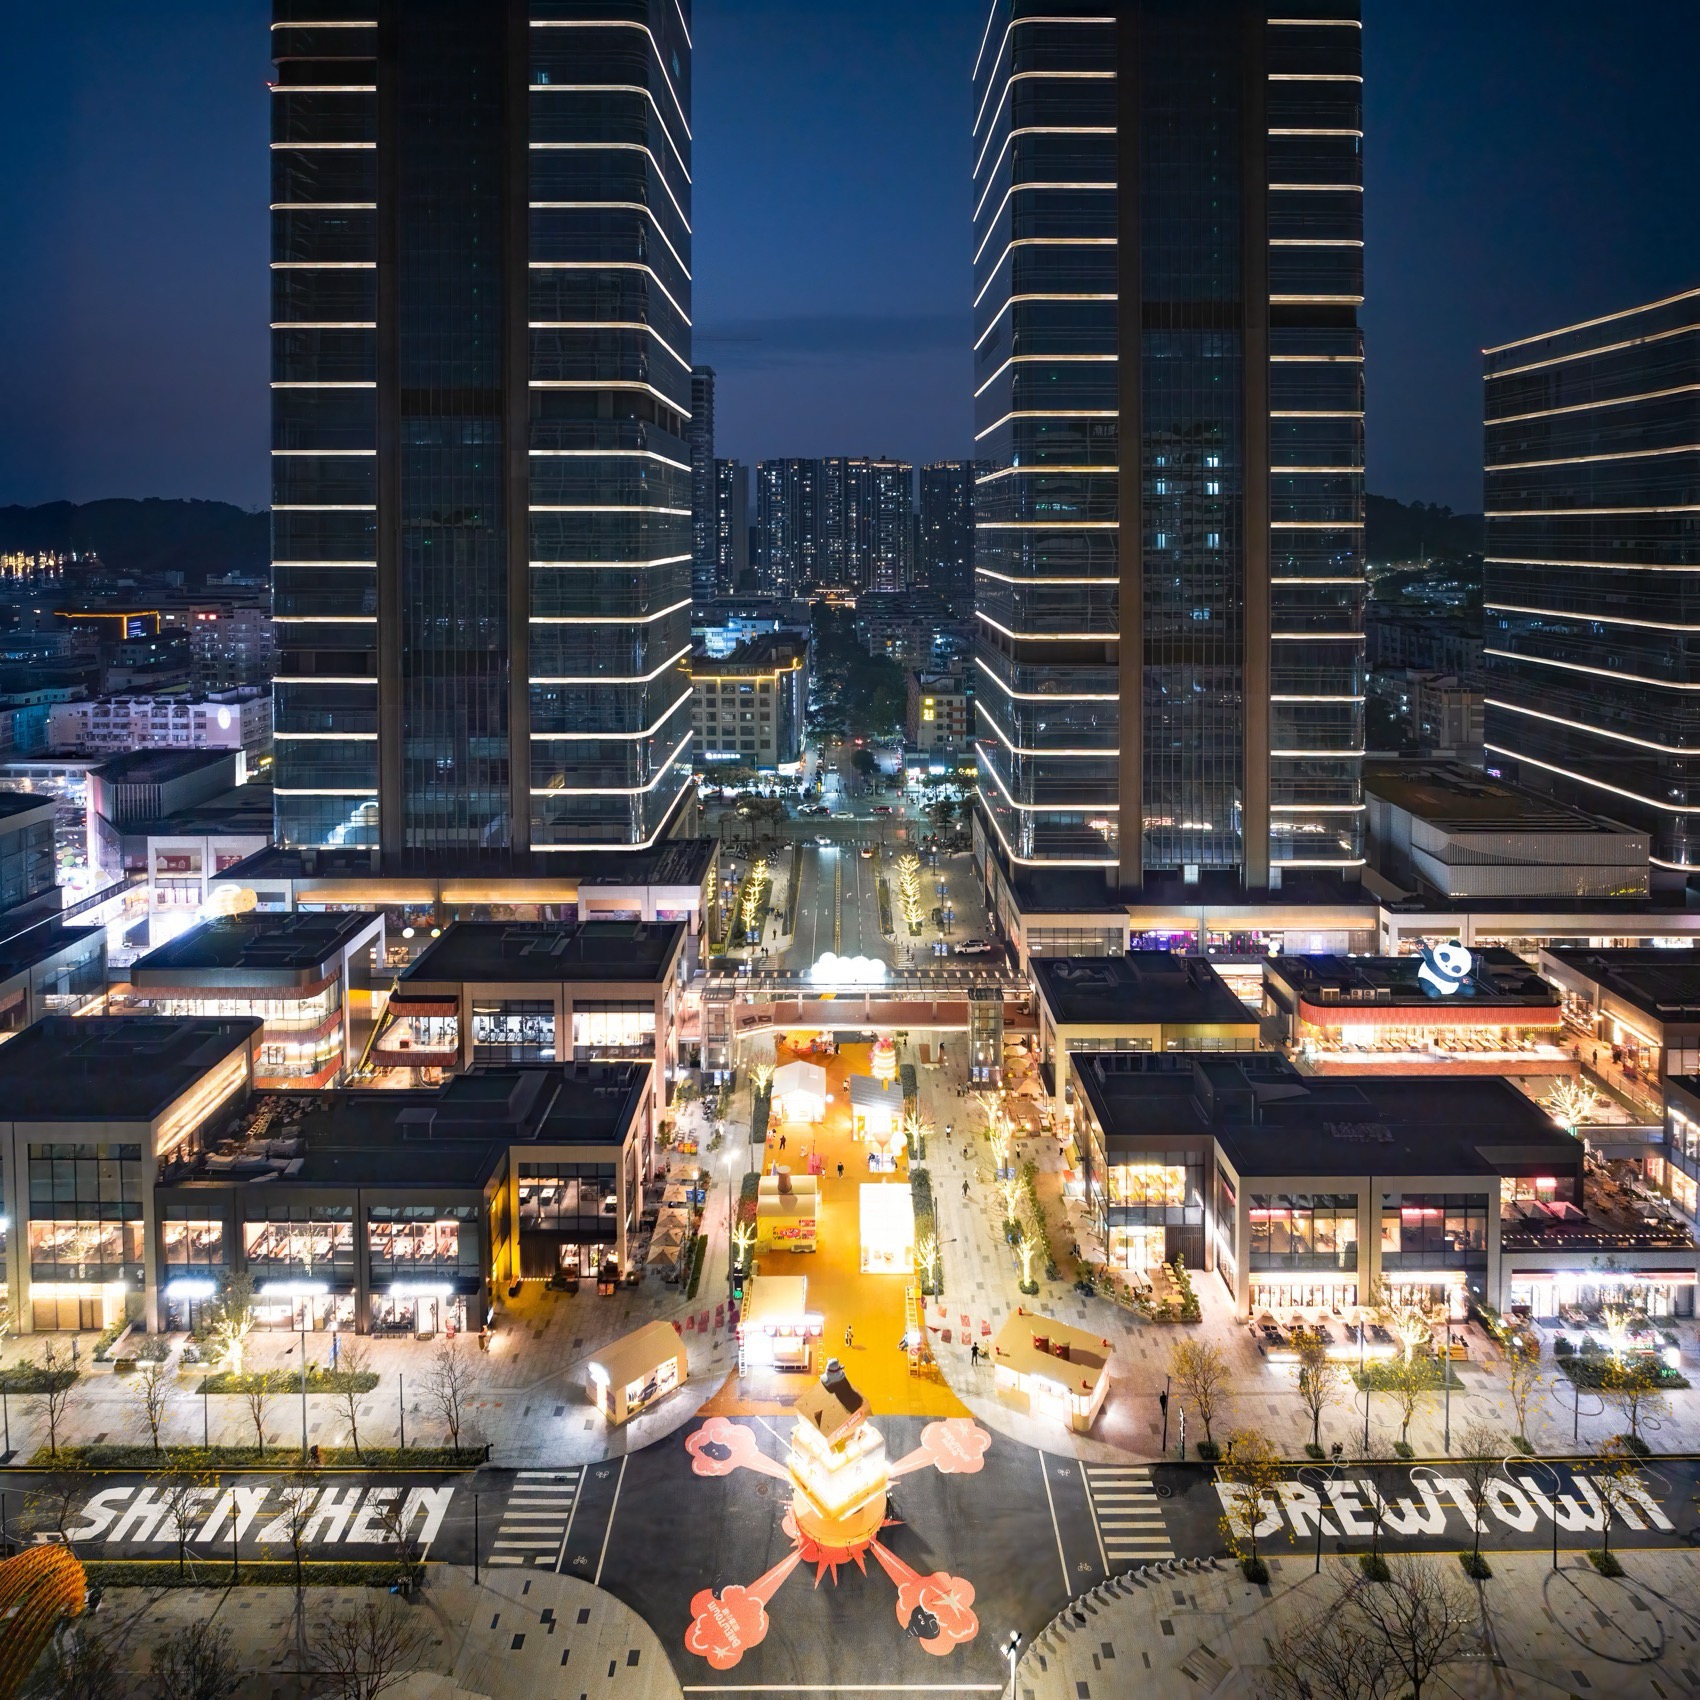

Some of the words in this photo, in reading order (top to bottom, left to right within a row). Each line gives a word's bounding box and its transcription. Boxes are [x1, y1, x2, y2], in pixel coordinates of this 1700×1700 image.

[66, 1487, 455, 1542] SHENZHEN
[1214, 1476, 1677, 1537] BREWTOWN
[707, 1601, 741, 1648] BREWTOWN
